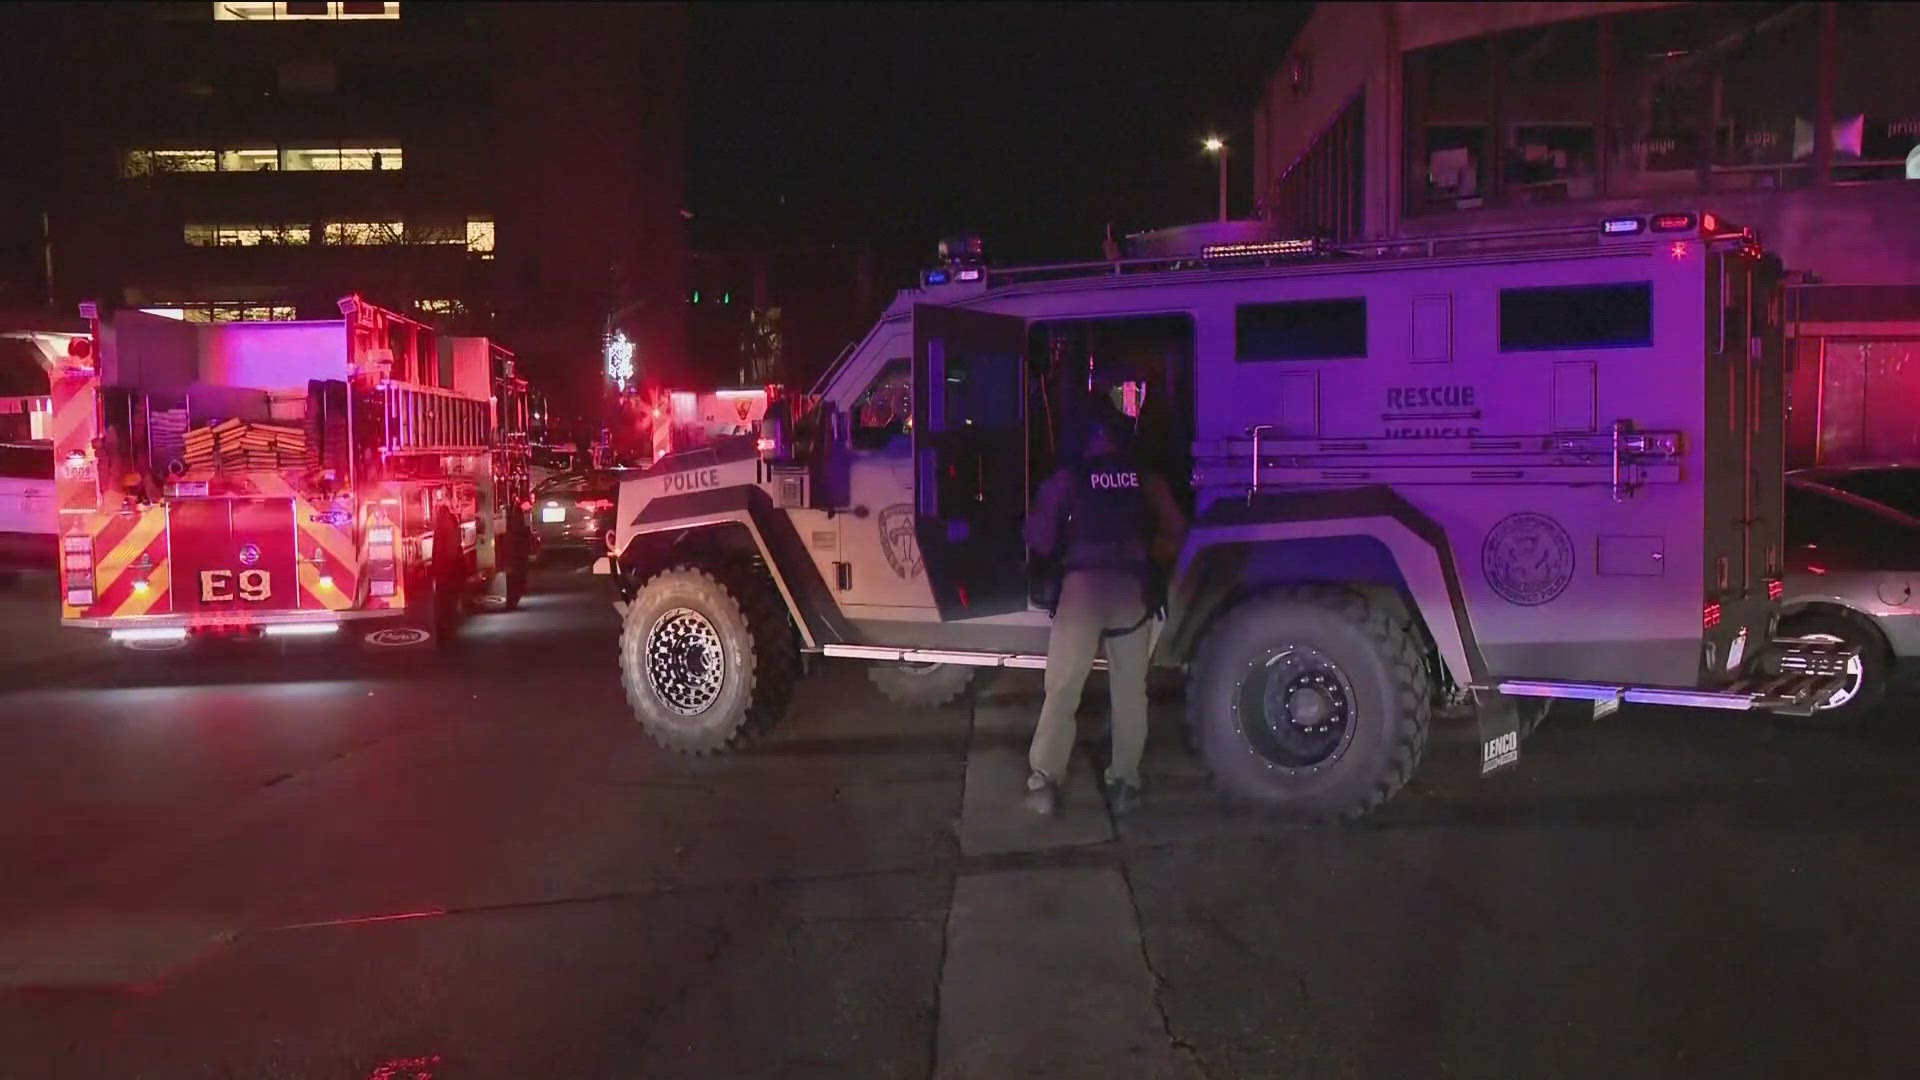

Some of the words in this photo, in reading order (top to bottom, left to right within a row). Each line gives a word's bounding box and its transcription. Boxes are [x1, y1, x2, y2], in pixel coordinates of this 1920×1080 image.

[1386, 386, 1475, 409] RESCUE
[663, 468, 720, 493] POLICE
[1090, 472, 1139, 489] POLICE
[200, 569, 272, 602] E9
[1484, 731, 1517, 762] LENCO
